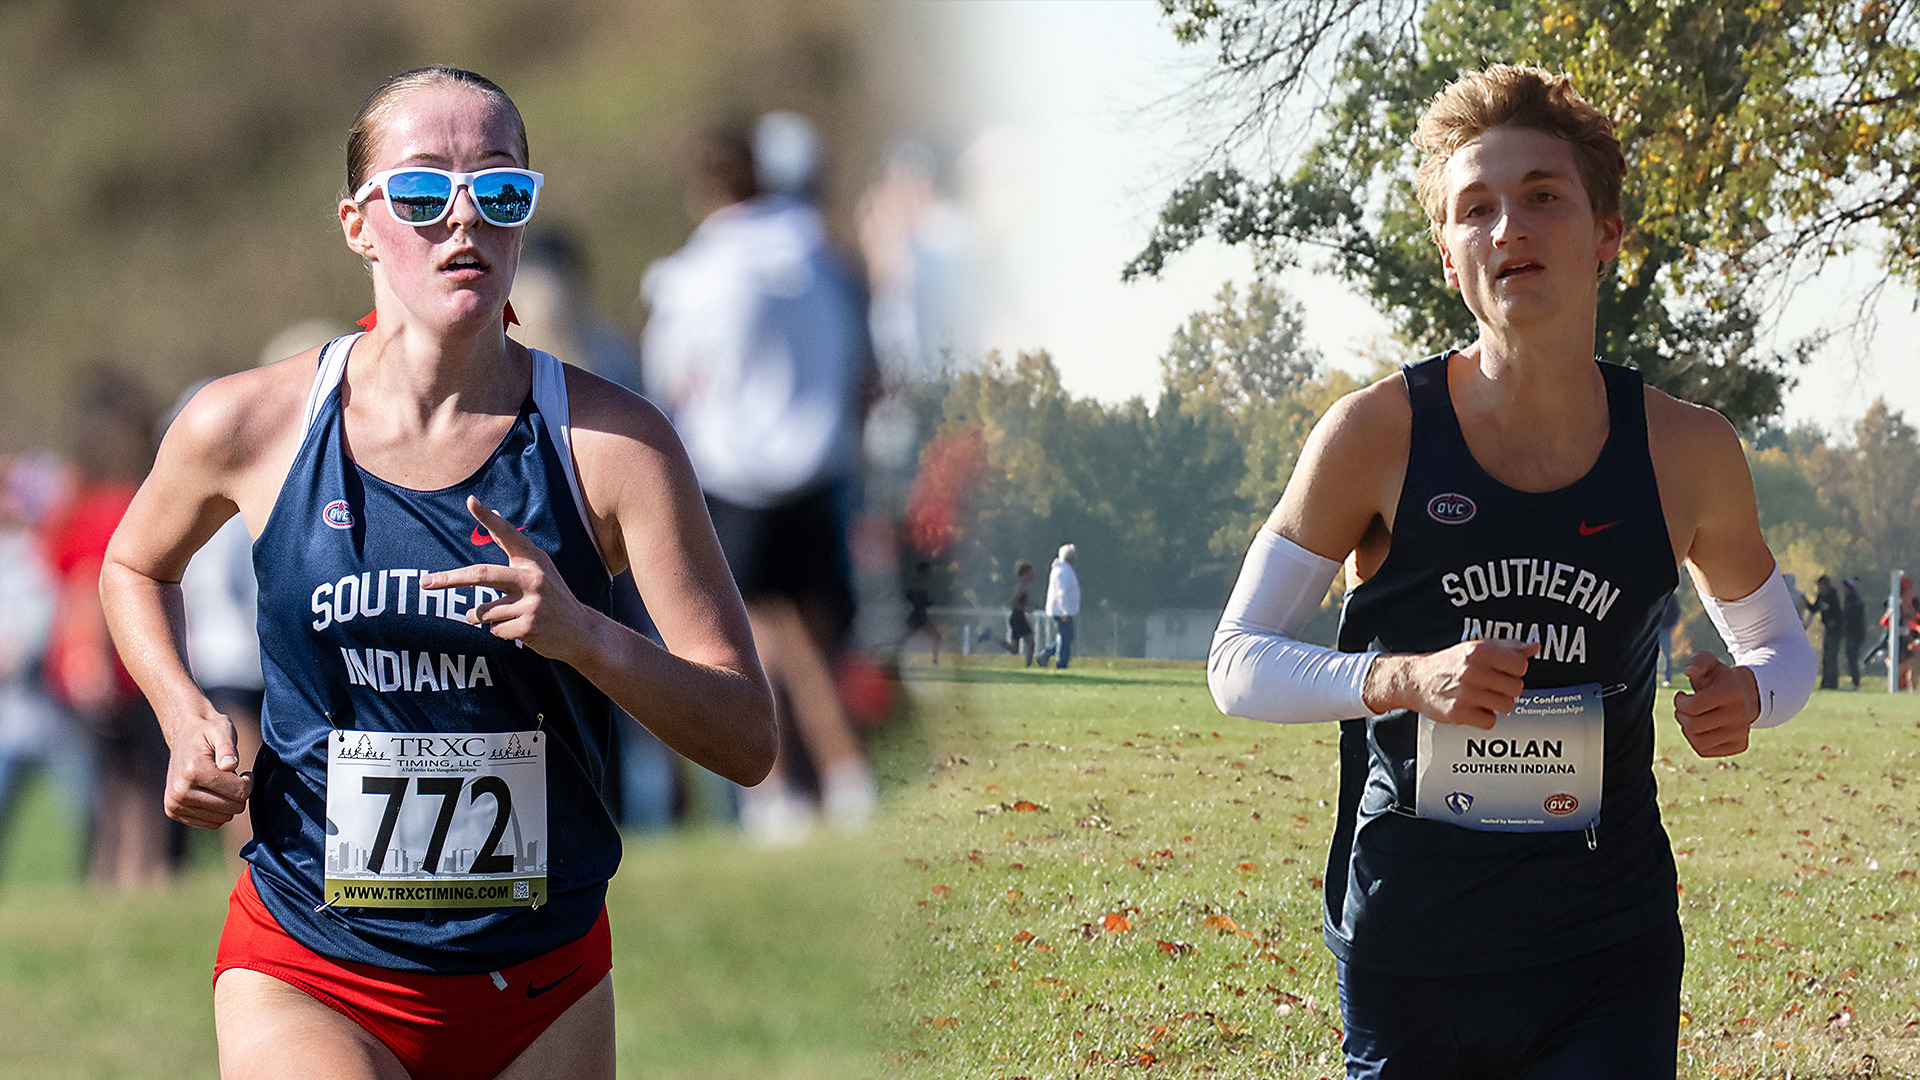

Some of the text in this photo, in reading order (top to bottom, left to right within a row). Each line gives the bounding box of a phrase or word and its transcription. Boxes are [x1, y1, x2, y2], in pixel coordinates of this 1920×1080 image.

[330, 508, 350, 521] OVC
[1437, 502, 1465, 515] OVC
[1441, 558, 1621, 622] SOUTHERN
[311, 568, 523, 649] SOUTHE
[340, 647, 493, 693] INDIANA
[1532, 694, 1582, 705] Conference
[1514, 704, 1584, 716] Championships
[390, 737, 486, 757] TRXC
[1466, 738, 1562, 758] NOLAN
[396, 759, 482, 768] TIMING, LLC
[1452, 763, 1576, 774] SOUTHERN INDIANA
[1550, 800, 1572, 810] OVC
[361, 775, 515, 876] 772
[343, 886, 509, 900] WWW.TRXCTIMING.COM
